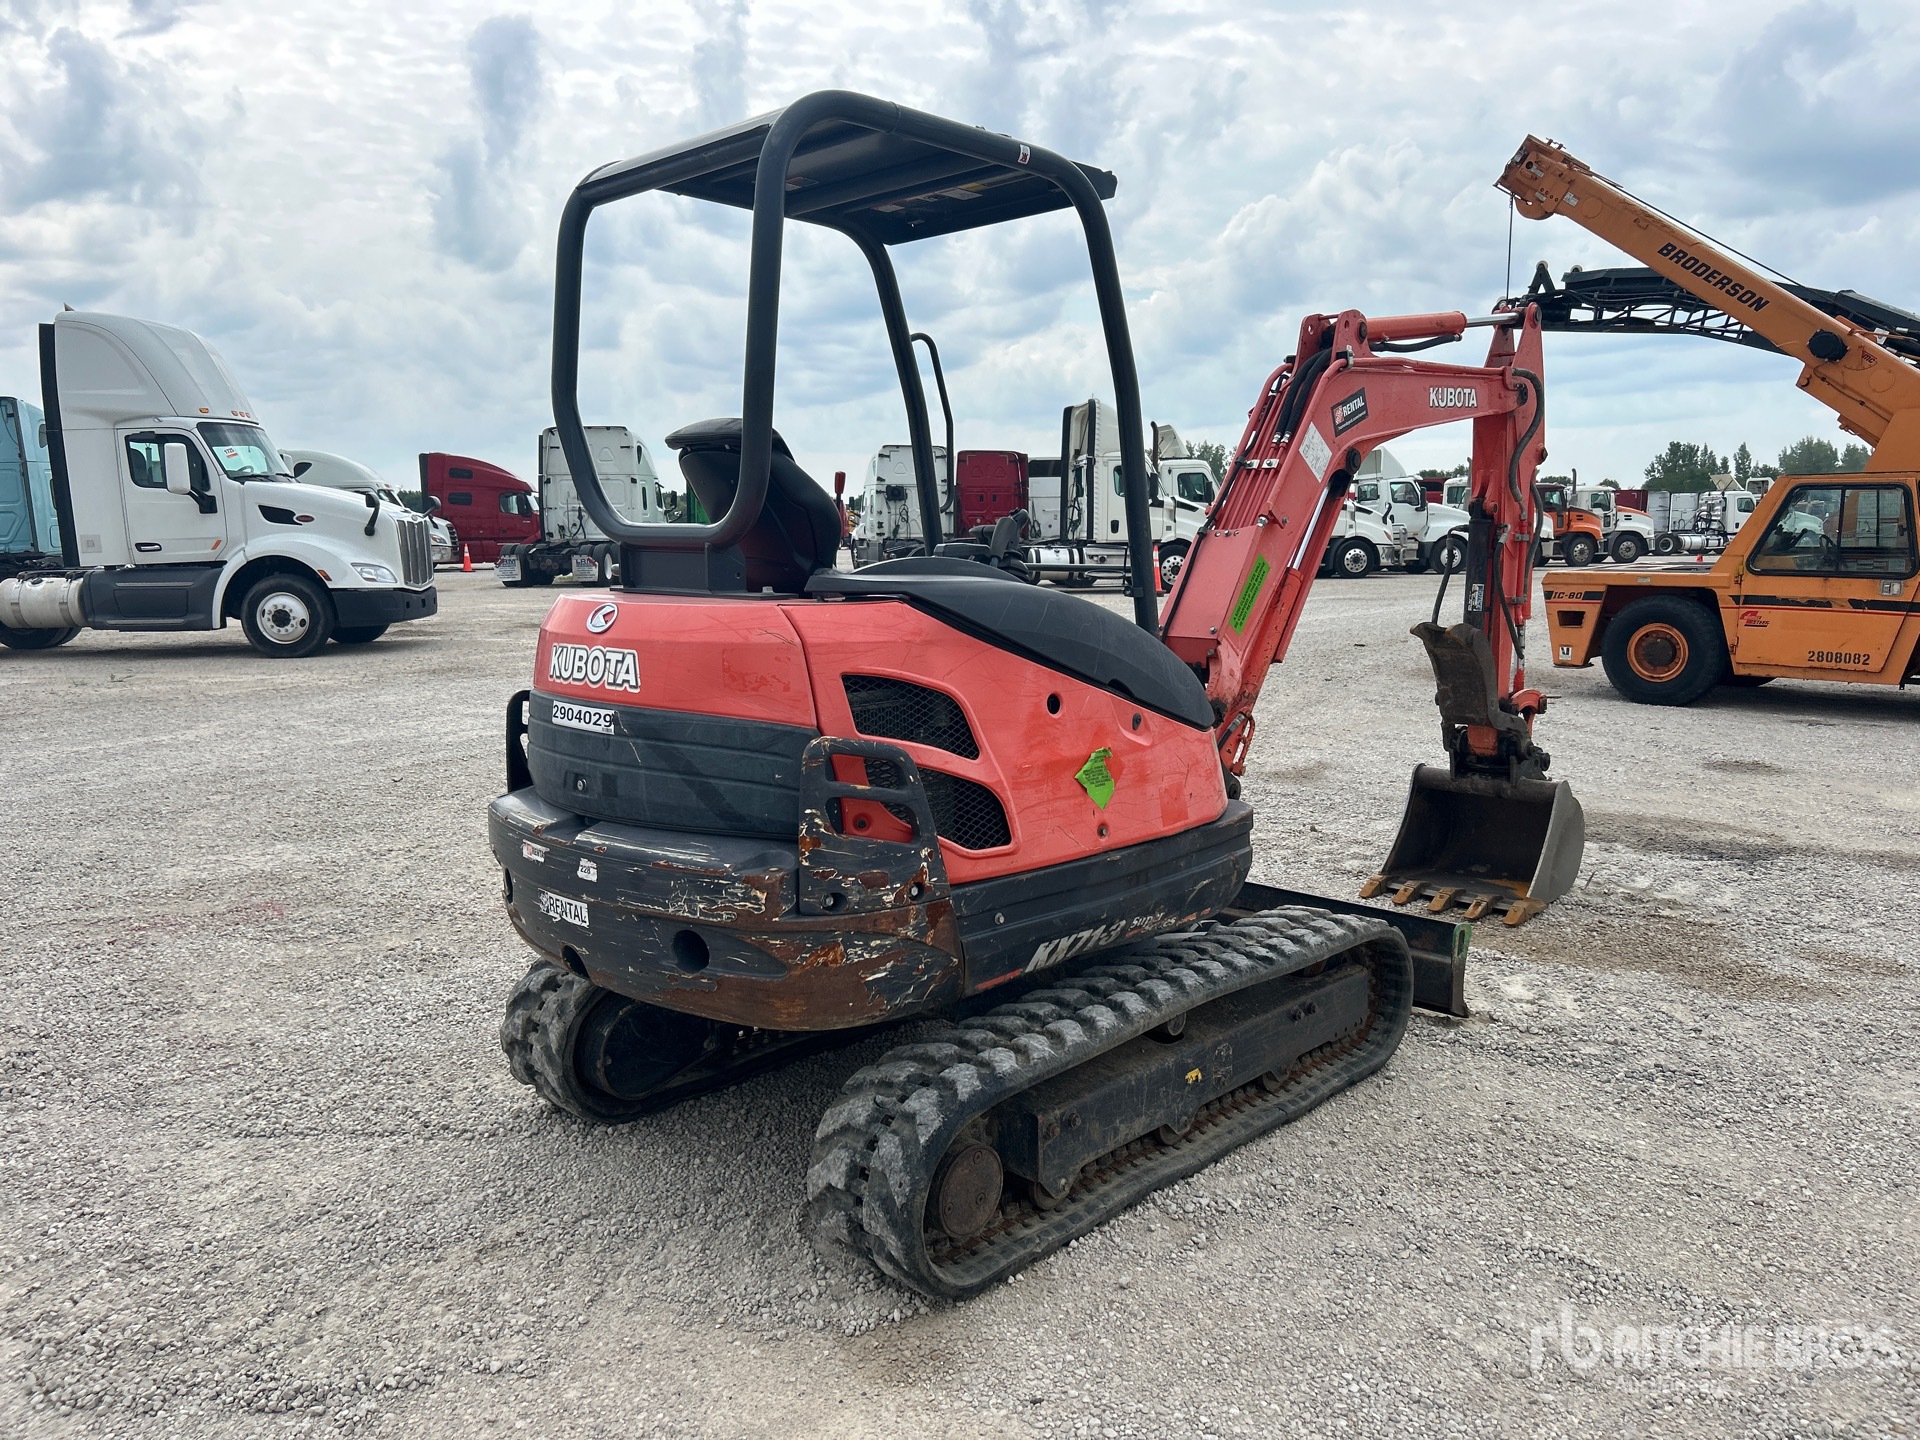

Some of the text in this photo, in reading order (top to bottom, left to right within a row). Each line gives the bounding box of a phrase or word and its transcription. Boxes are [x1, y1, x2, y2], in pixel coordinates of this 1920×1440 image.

[1657, 242, 1770, 312] BRODERSON
[1342, 396, 1365, 417] RENTAL
[1429, 386, 1478, 408] KUBOTA
[1553, 591, 1583, 600] IC-80
[549, 644, 640, 691] KUBOTA
[1807, 650, 1871, 666] 2808082
[552, 704, 614, 728] 2904029
[548, 896, 588, 924] RENTAL
